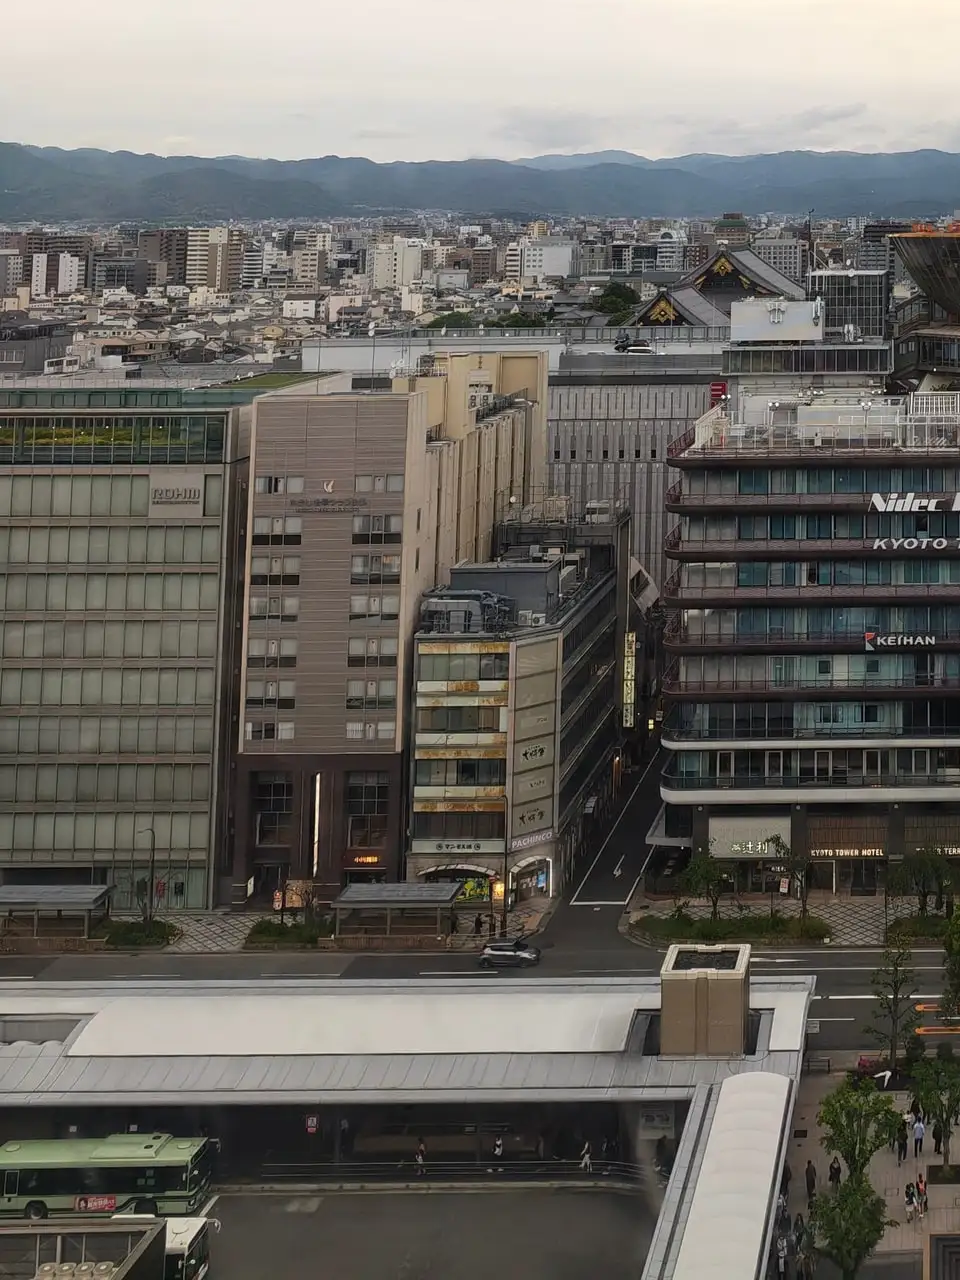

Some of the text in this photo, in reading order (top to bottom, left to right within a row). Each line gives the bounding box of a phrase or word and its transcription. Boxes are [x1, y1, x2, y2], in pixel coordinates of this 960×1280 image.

[152, 487, 200, 499] ROHM
[868, 492, 945, 512] Nidec
[873, 538, 947, 549] KYOTO
[877, 635, 936, 646] KEIHAN
[511, 832, 553, 848] PACHINCO
[811, 848, 884, 857] KYOTO TOWER HOTEL
